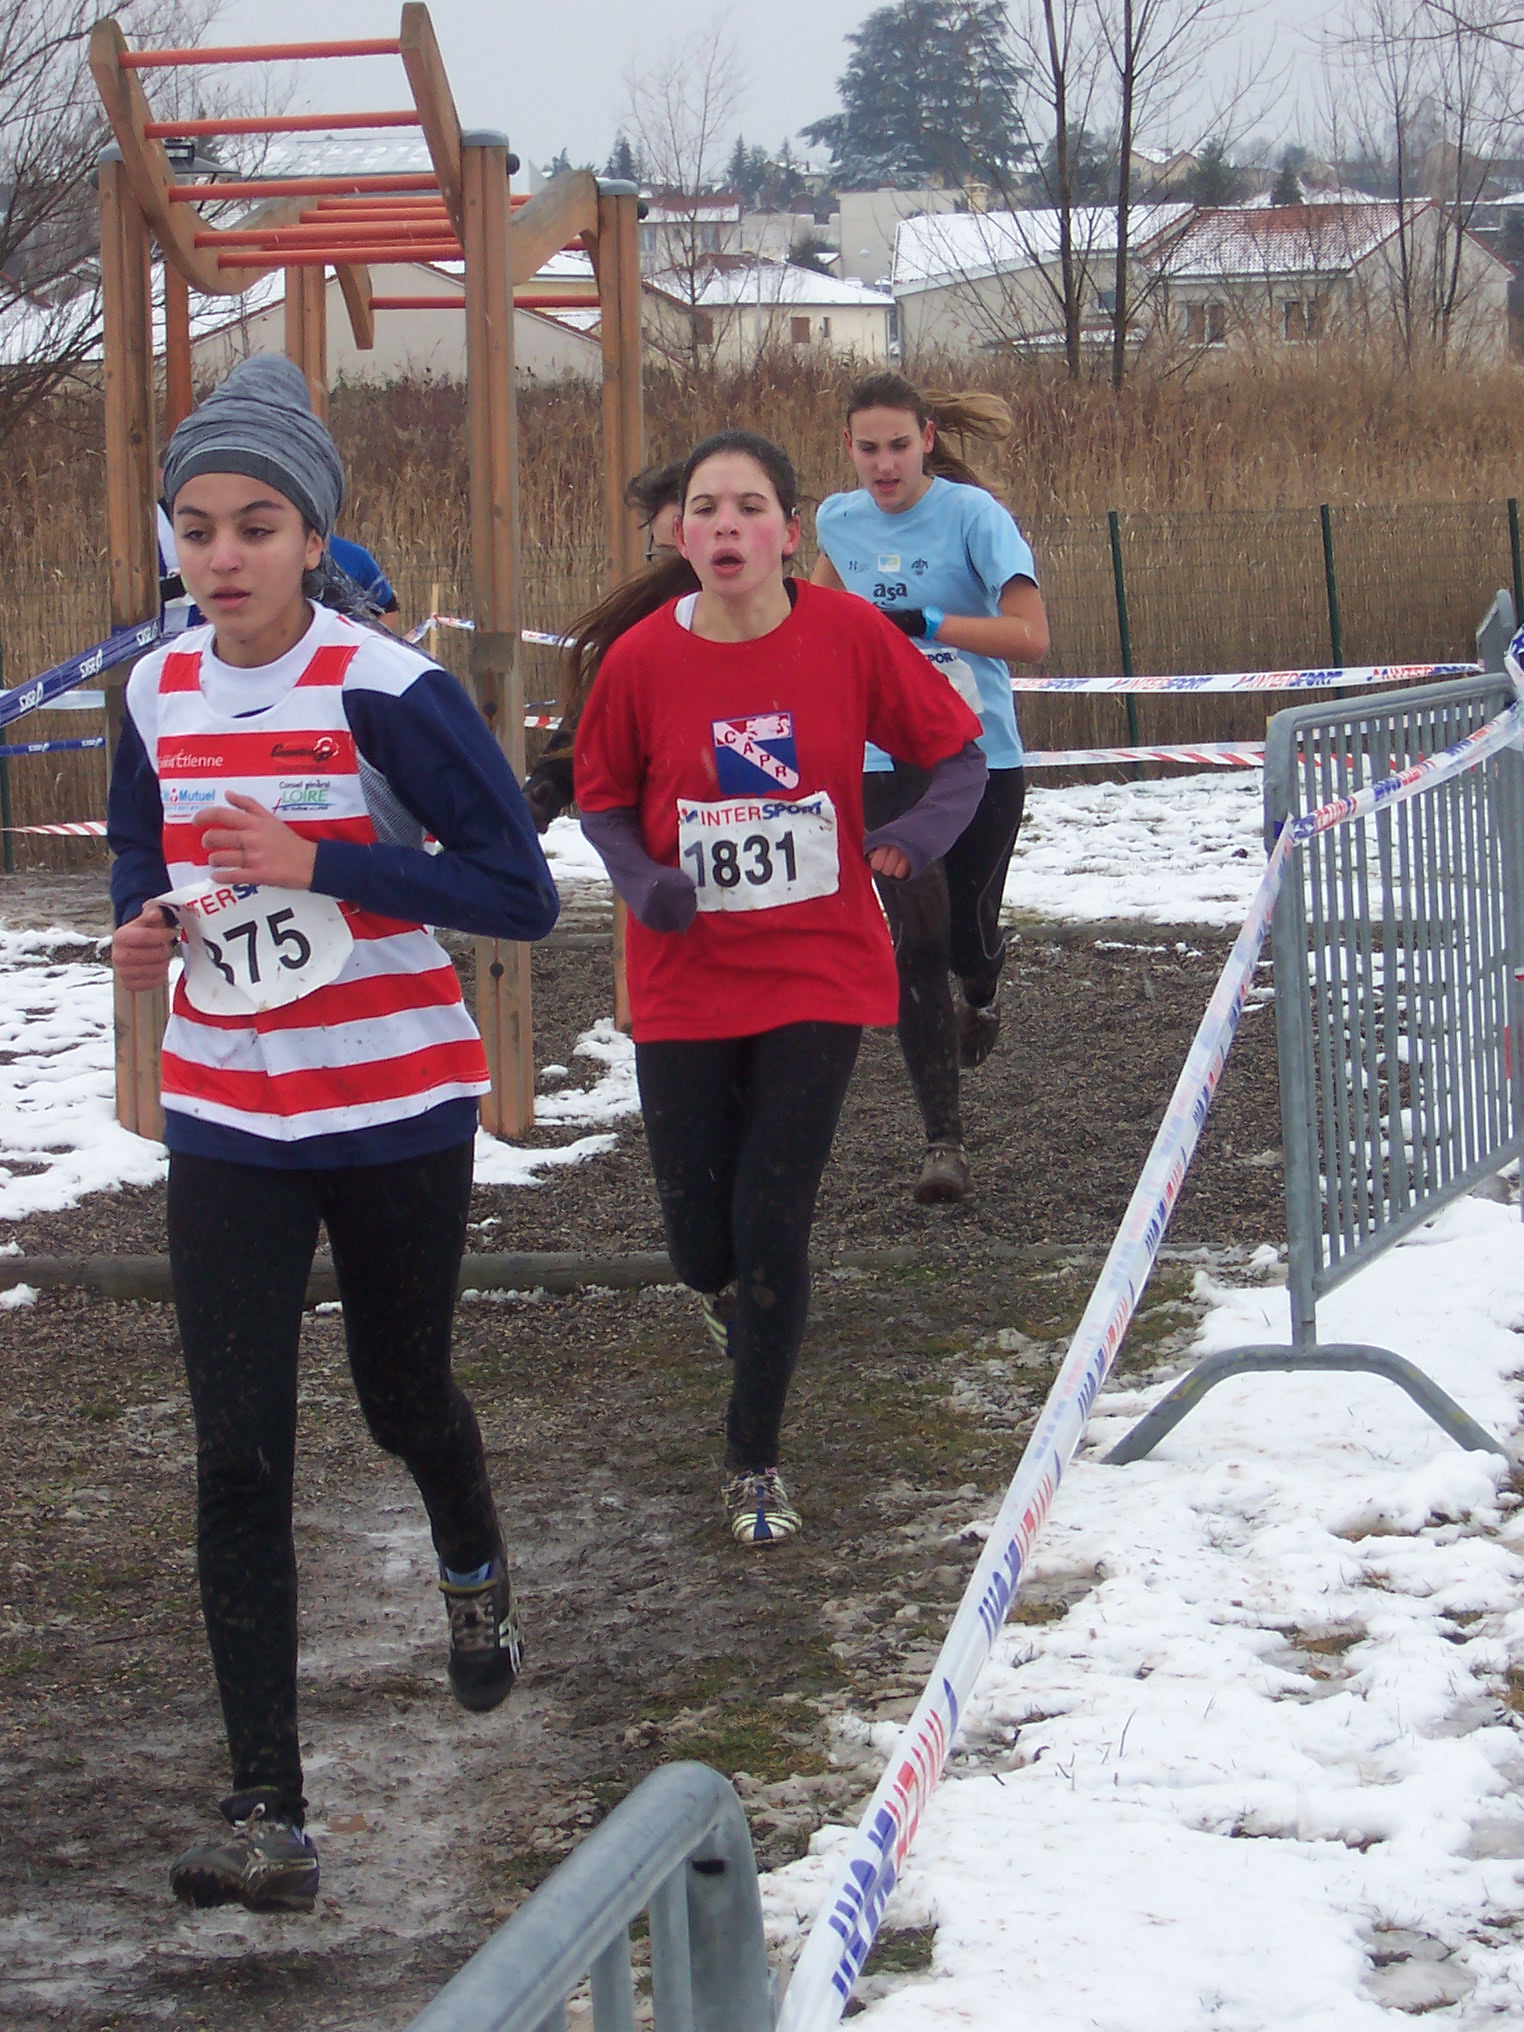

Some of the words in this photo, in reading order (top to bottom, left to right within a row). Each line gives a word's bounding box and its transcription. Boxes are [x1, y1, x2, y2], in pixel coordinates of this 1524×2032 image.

[873, 582, 907, 601] asa
[281, 788, 329, 803] LOIRE
[700, 801, 823, 827] INTERSPORT
[683, 830, 798, 888] 1831
